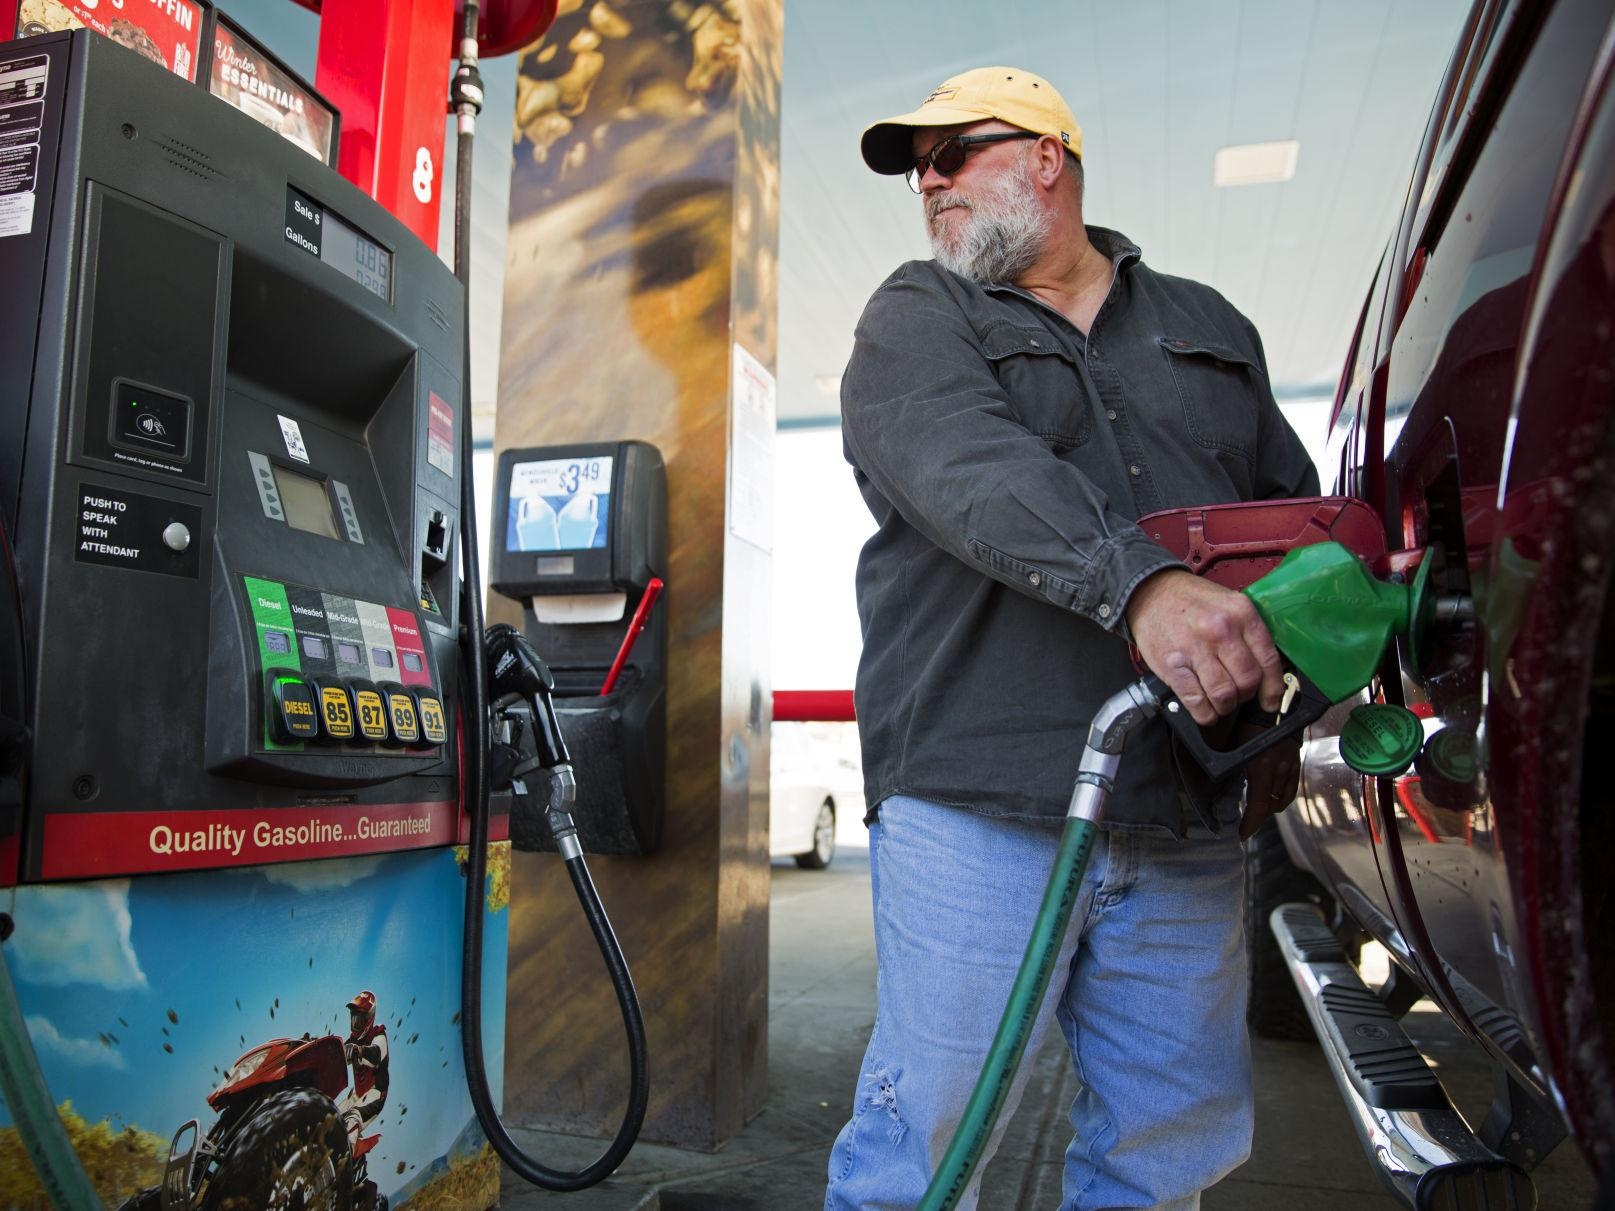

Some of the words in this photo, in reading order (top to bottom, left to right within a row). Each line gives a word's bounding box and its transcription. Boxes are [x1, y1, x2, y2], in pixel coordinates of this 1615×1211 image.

[215, 40, 257, 76] Winter
[221, 63, 304, 114] ESSENTIALS
[413, 146, 433, 203] 8
[294, 200, 313, 221] Sale
[314, 213, 321, 226] $
[285, 226, 319, 256] Gallons
[83, 495, 112, 510] PUSH
[114, 501, 127, 512] TO
[82, 511, 118, 525] SPEAK
[82, 525, 108, 539] WITH
[80, 541, 140, 559] ATTENDANT
[258, 597, 282, 610] Diesel
[291, 605, 324, 618] Unleaded
[326, 611, 359, 625] Mid-Grade
[393, 624, 418, 636] Premium
[284, 700, 314, 715] DIESEL
[326, 701, 349, 723] 85
[361, 704, 381, 725] 87
[394, 708, 414, 727] 89
[424, 710, 443, 730] 91
[1359, 710, 1385, 739] DIESEL
[148, 825, 245, 856] Quality
